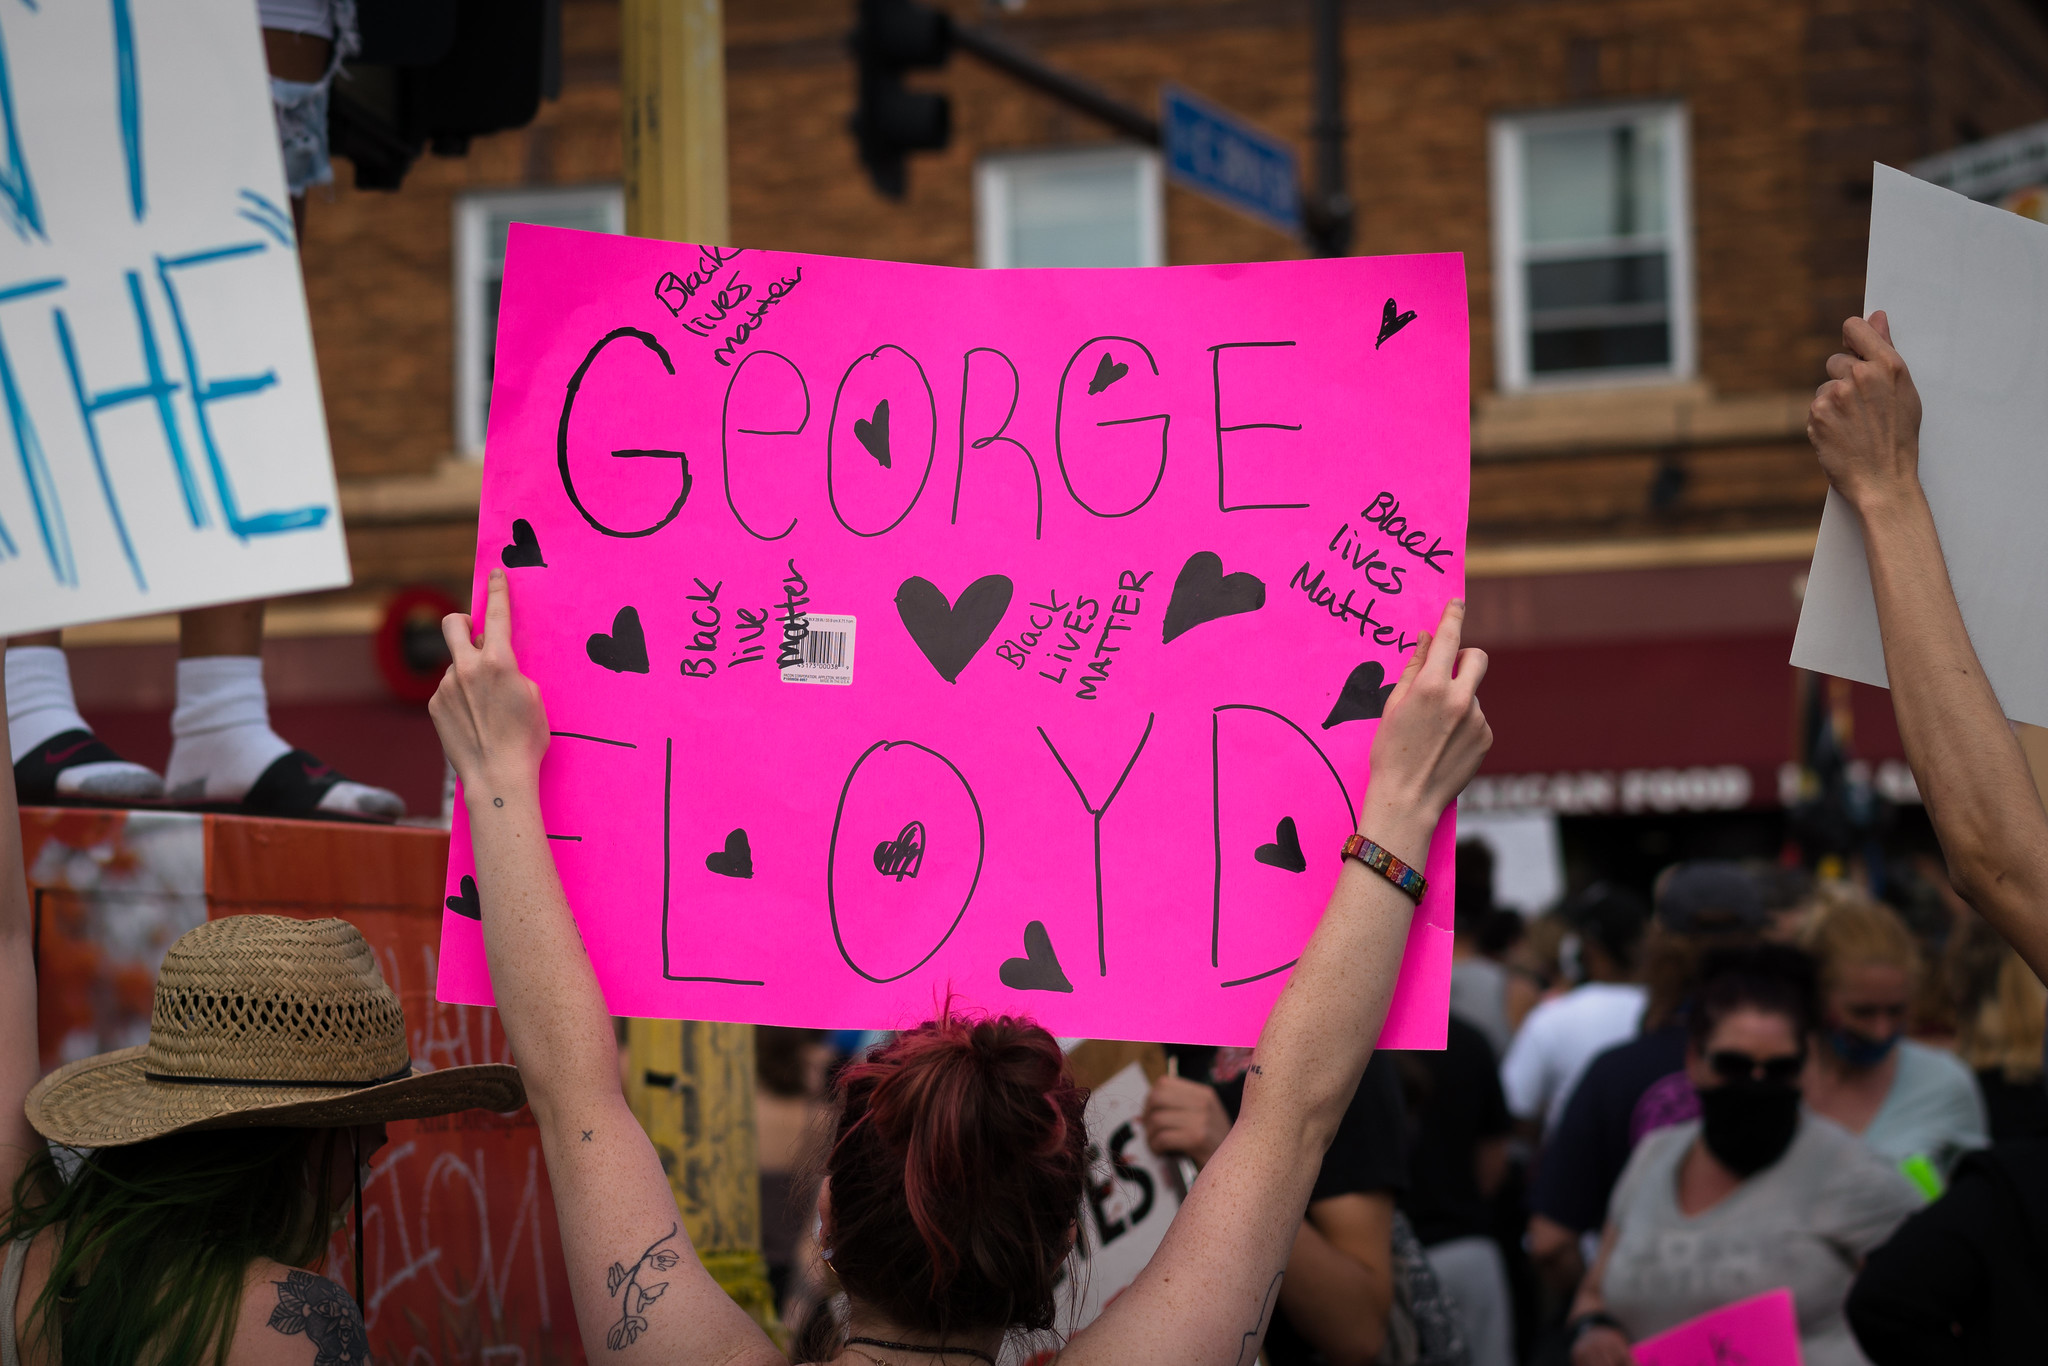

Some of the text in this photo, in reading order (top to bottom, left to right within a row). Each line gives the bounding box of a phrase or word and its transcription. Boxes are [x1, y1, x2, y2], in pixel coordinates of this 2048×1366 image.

[655, 245, 744, 318] Black
[682, 270, 753, 337] lives
[1328, 522, 1407, 594] lives
[680, 577, 723, 679] Black
[1075, 569, 1154, 700] MATTER
[1289, 560, 1417, 654] Matter
